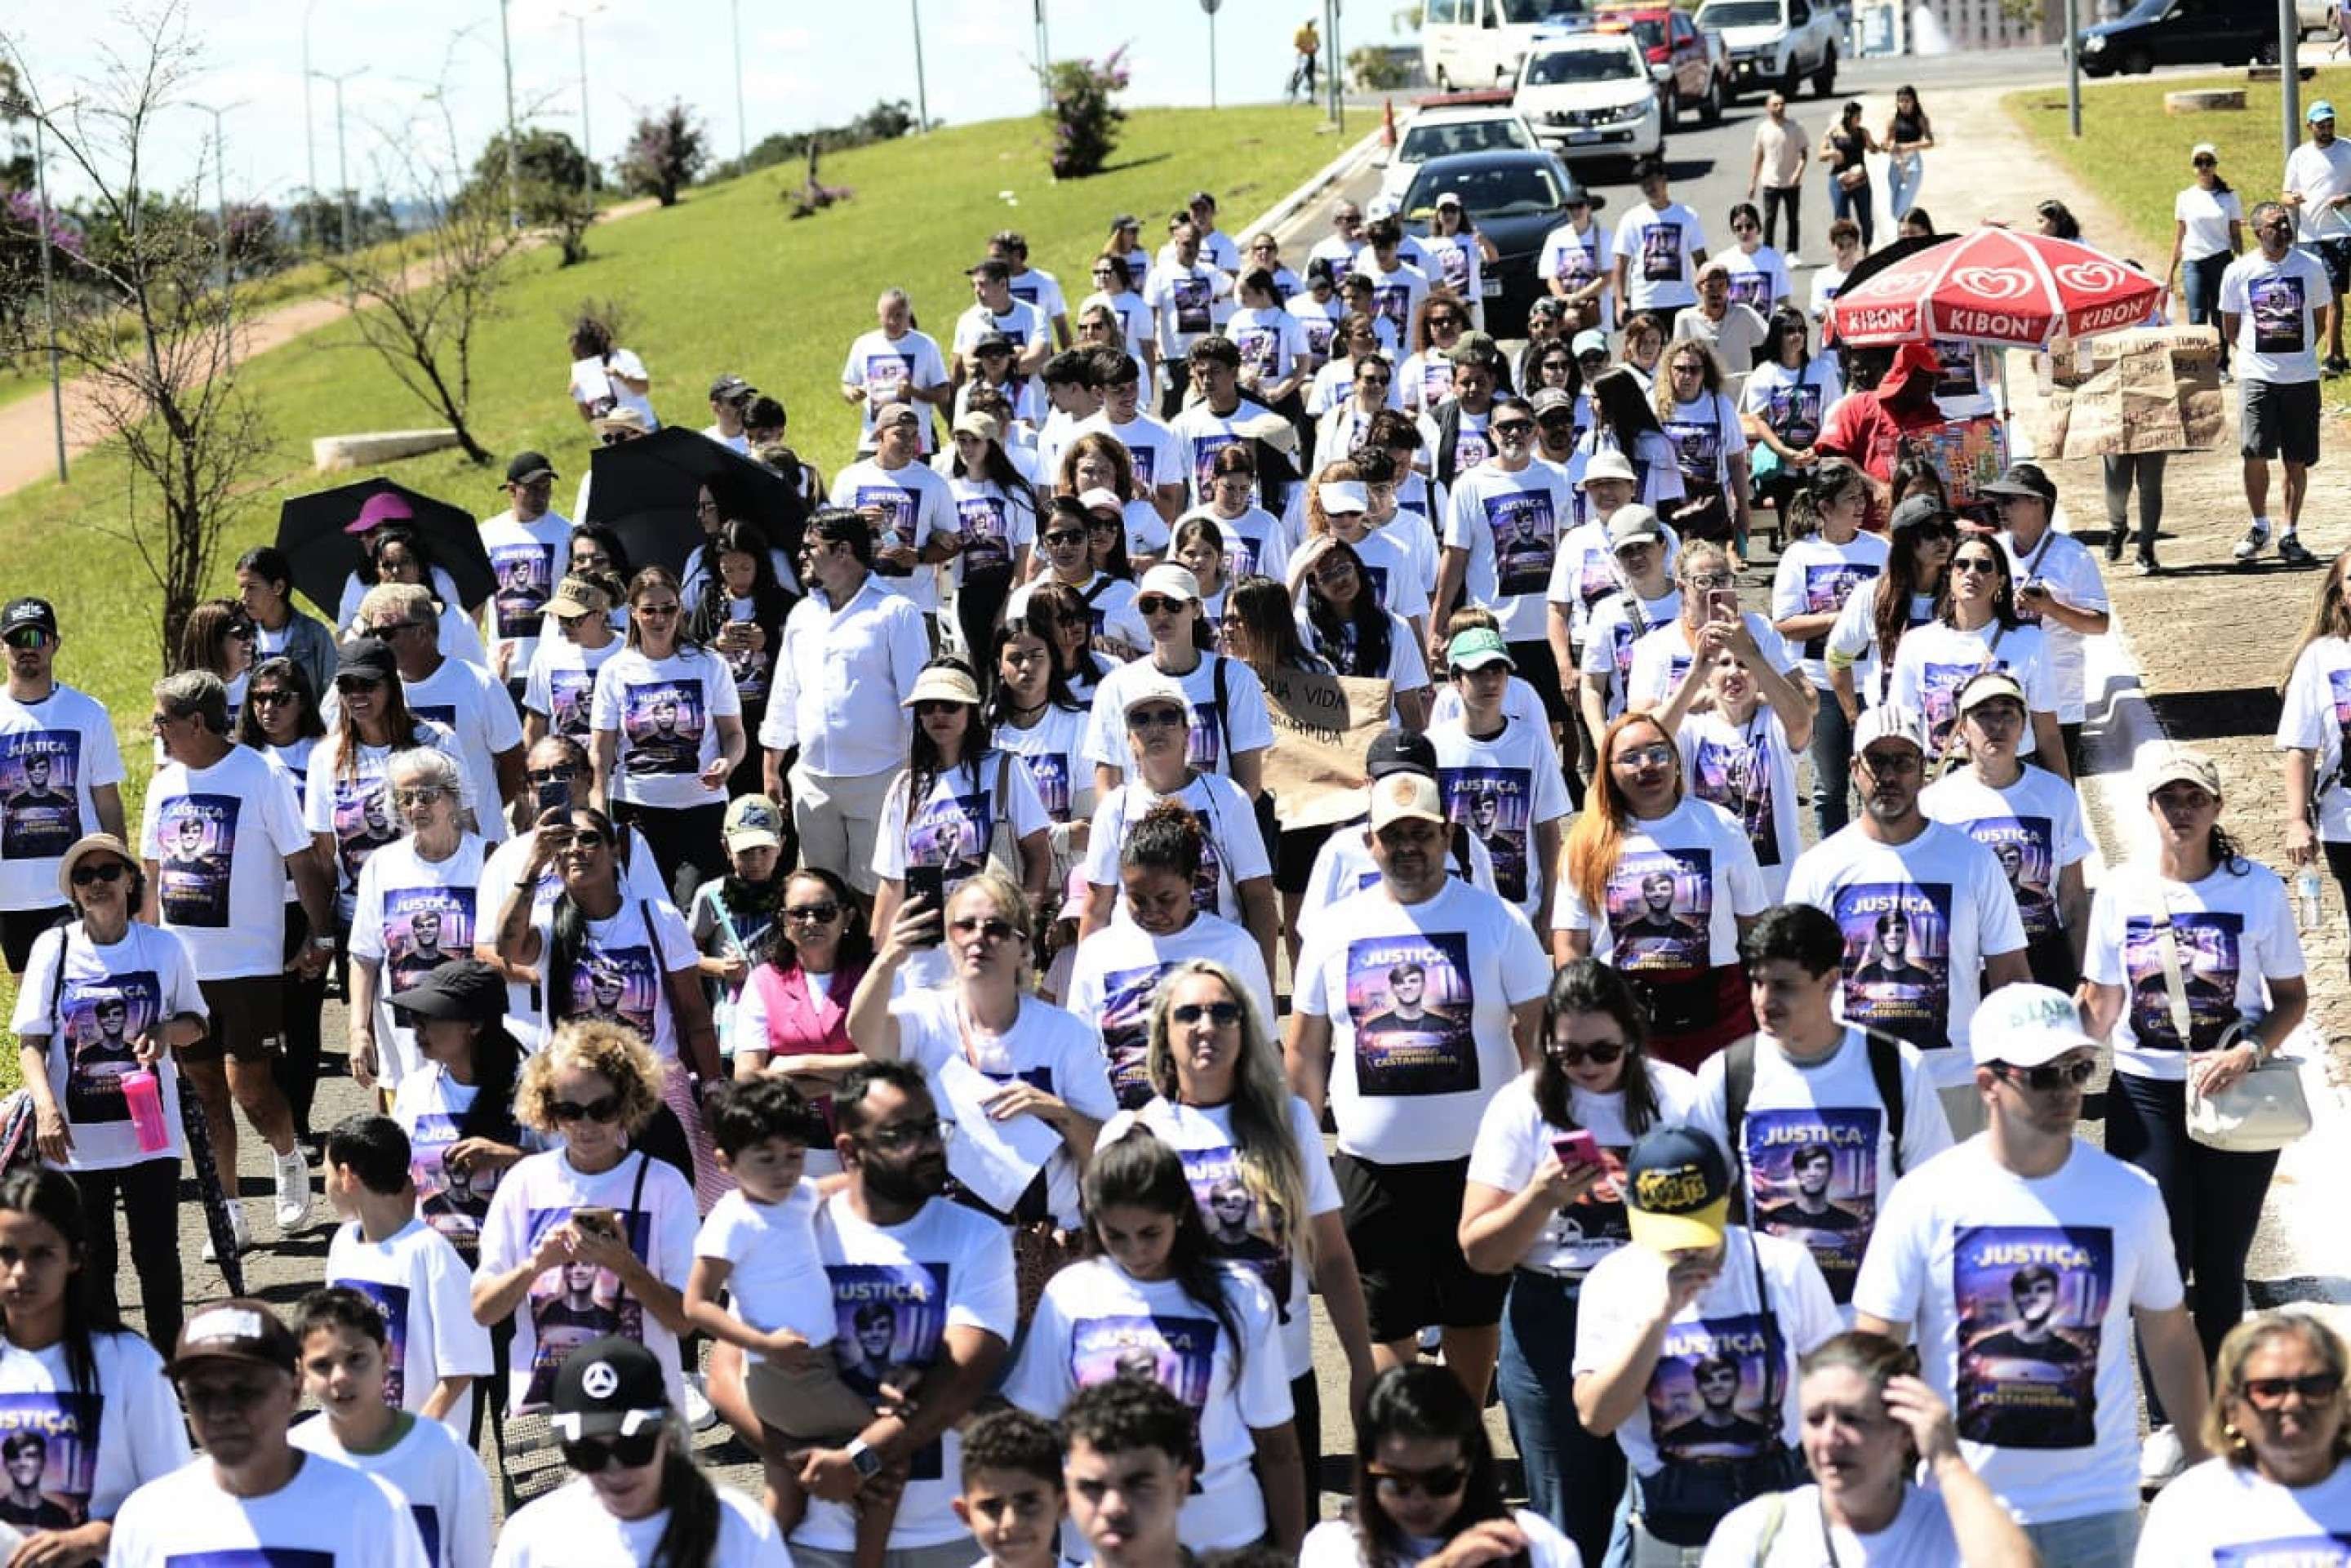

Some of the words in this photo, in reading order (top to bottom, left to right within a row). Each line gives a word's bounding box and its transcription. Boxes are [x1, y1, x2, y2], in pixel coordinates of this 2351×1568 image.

[1849, 308, 1905, 333] KIBON
[1950, 308, 2030, 338] KIBON
[2079, 297, 2143, 331] KIBON
[1306, 683, 1347, 710] VIDA
[1851, 895, 1935, 917] JUSTIÇA
[1363, 948, 1447, 968] JUSTIÇA
[1762, 1126, 1864, 1149] JUSTIÇA
[1976, 1242, 2091, 1273] JUSTIÇA
[0, 1409, 79, 1437] STIÇA
